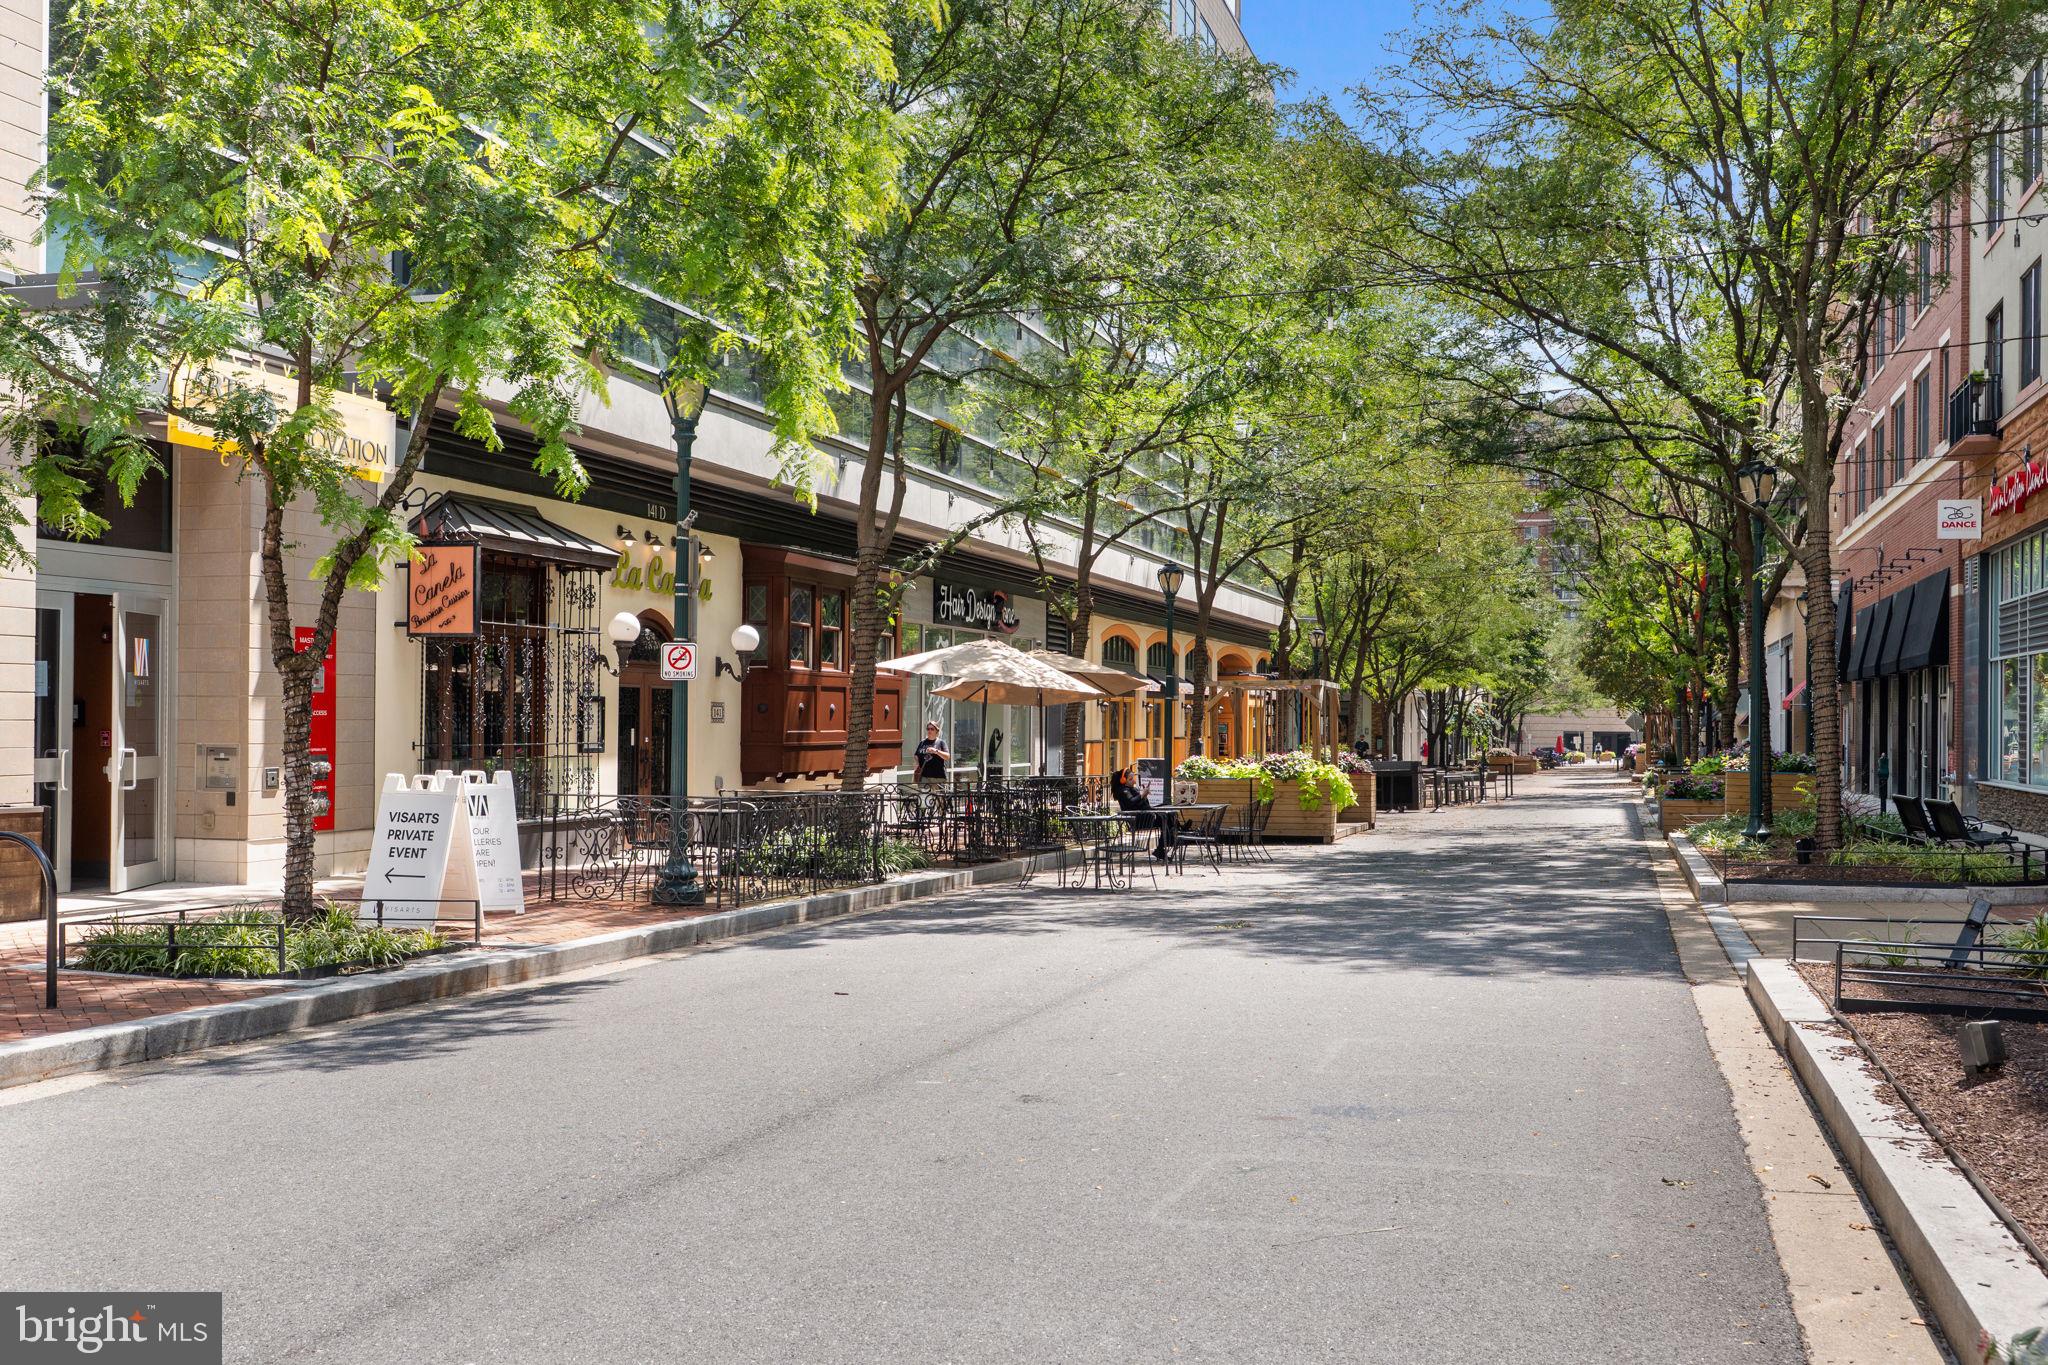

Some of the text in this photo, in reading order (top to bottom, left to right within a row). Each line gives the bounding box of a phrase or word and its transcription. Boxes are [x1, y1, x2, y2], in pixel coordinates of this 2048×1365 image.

[647, 503, 667, 520] 141 D
[1941, 521, 1977, 529] DANCE
[611, 549, 713, 601] La Caa
[414, 561, 466, 606] Canela
[940, 584, 966, 621] Hair
[965, 588, 997, 630] Design
[389, 811, 440, 824] VISARTS
[387, 829, 435, 842] PRIVATE
[472, 827, 490, 835] OUR
[473, 838, 502, 846] LLERIES
[388, 846, 428, 859] EVENT
[476, 848, 490, 857] ARE
[384, 904, 421, 914] VISARTS
